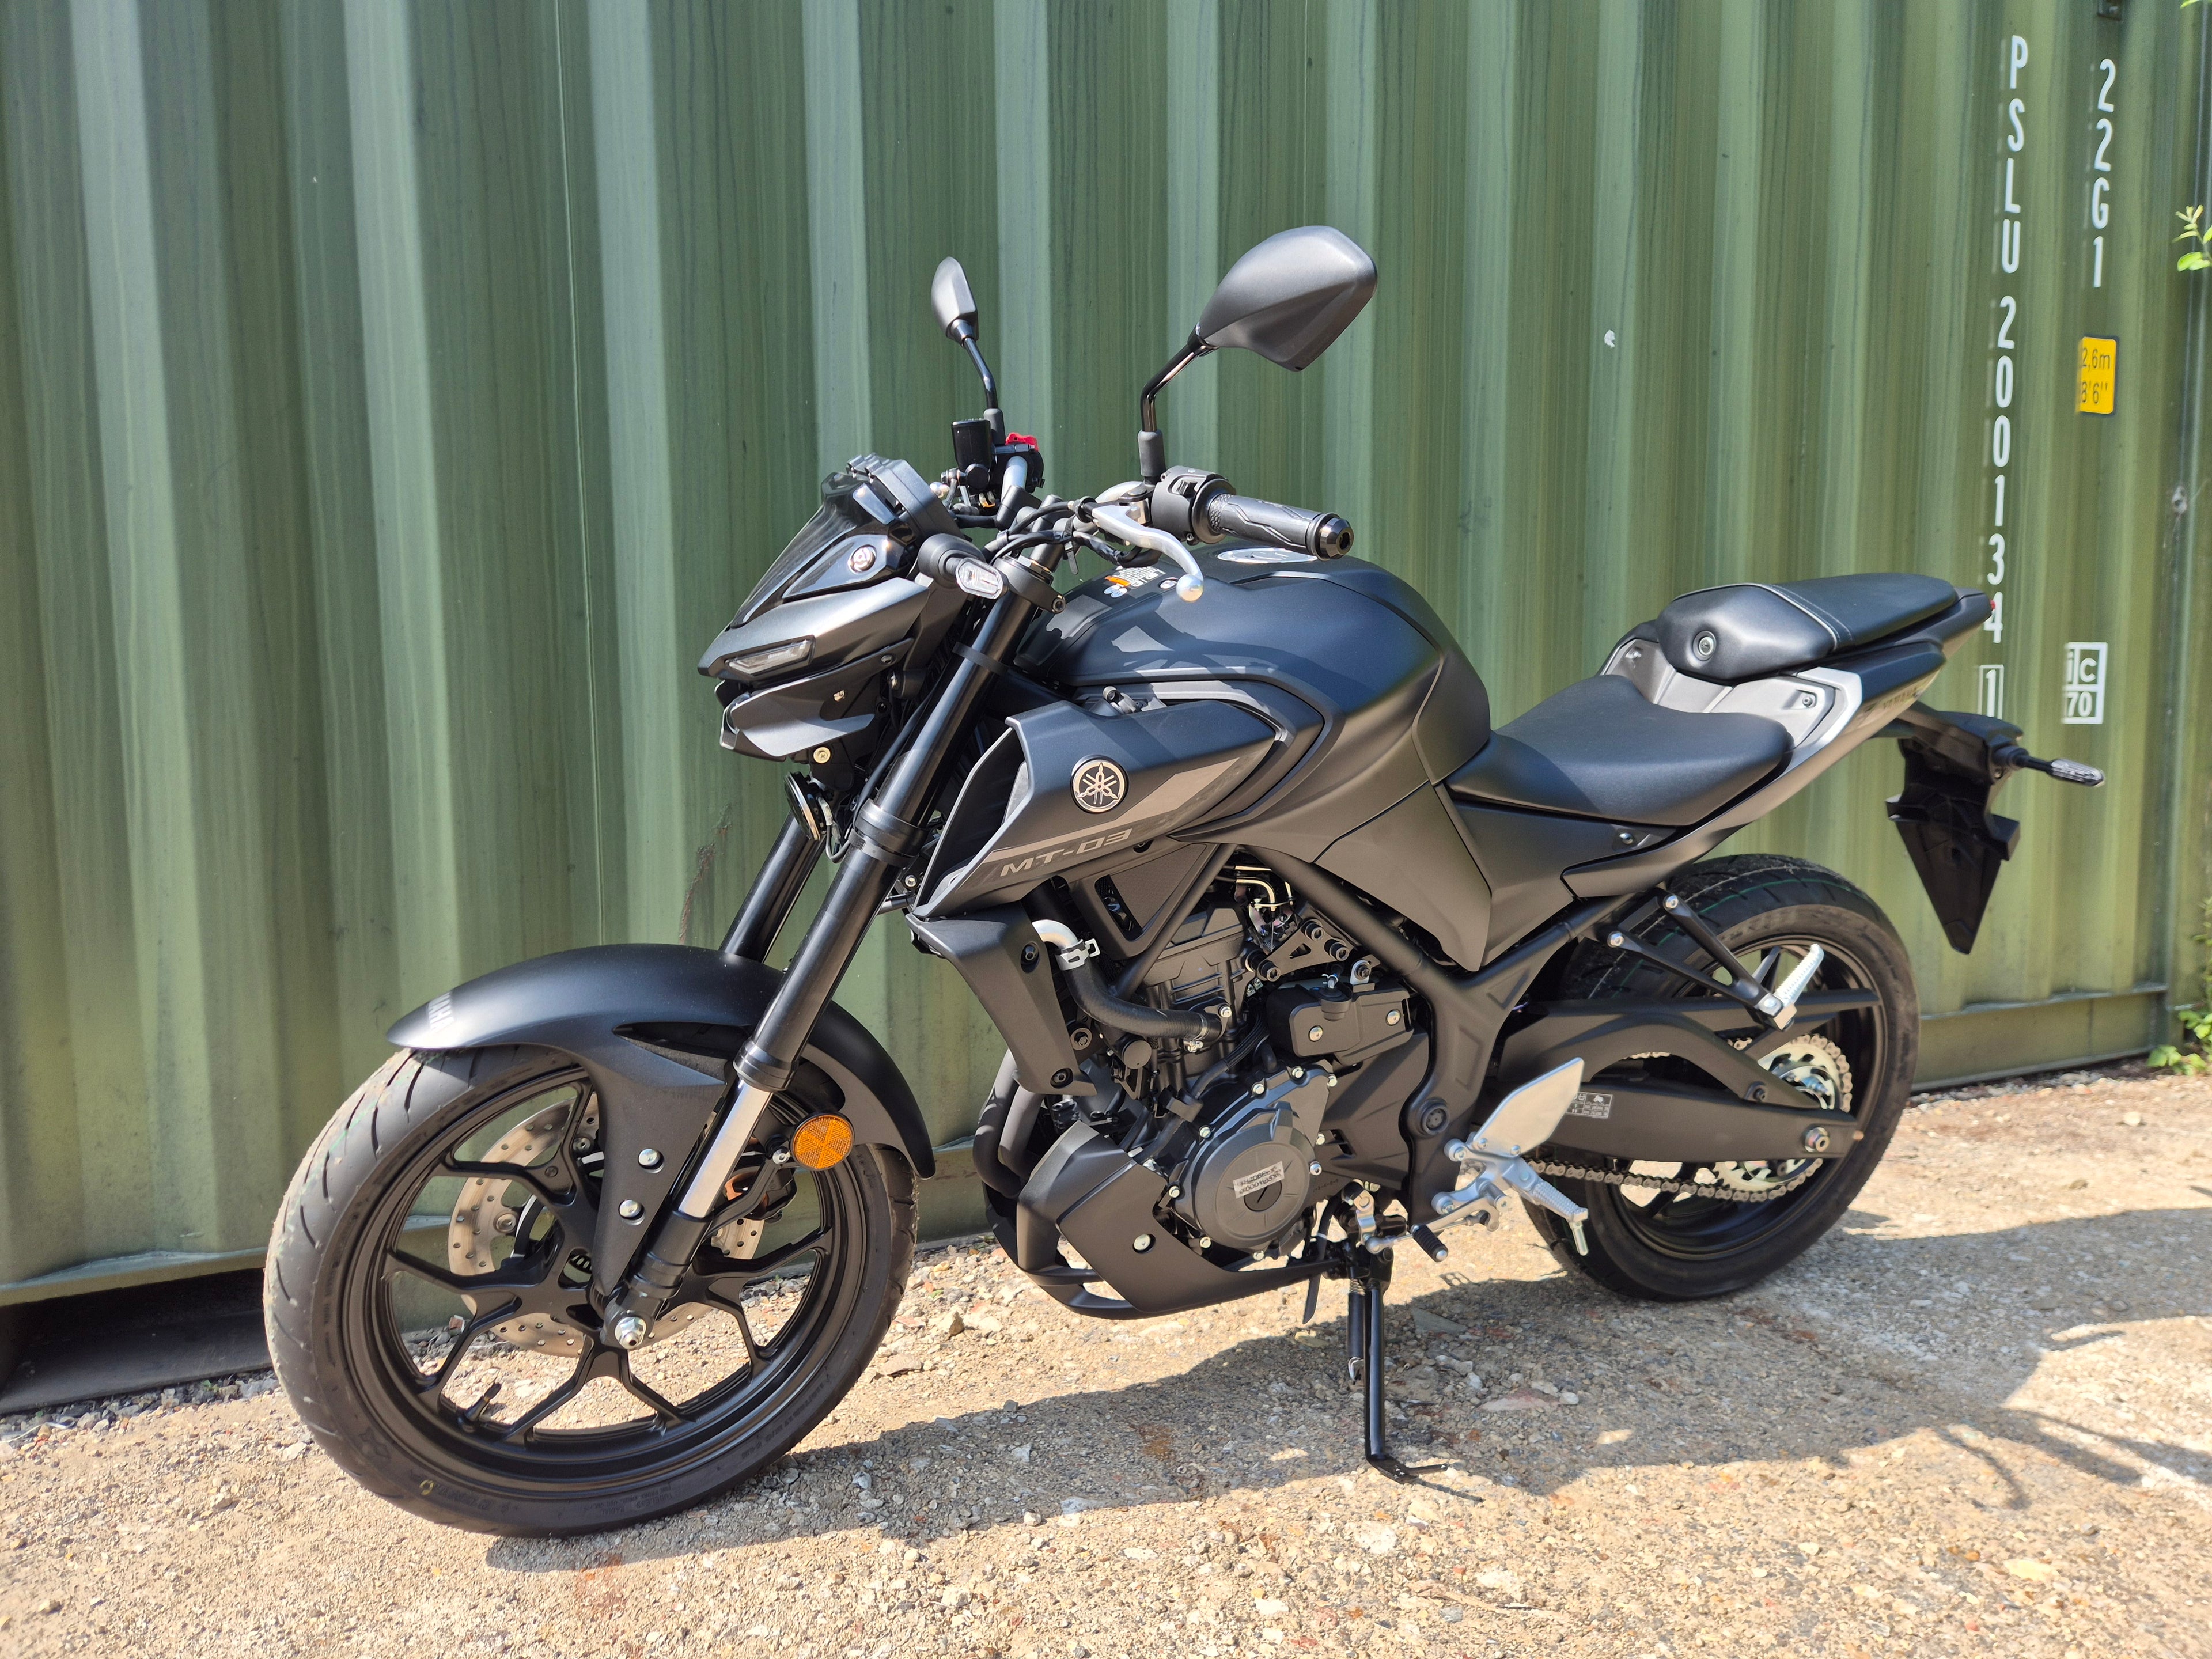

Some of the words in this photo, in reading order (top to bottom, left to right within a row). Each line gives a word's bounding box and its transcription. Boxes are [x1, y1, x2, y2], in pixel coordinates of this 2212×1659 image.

[2002, 35, 2028, 274] PSLU
[2092, 59, 2116, 287] 22G1
[1984, 295, 2016, 643] 200134
[2067, 691, 2093, 717] 70
[1000, 828, 1132, 877] MT-03
